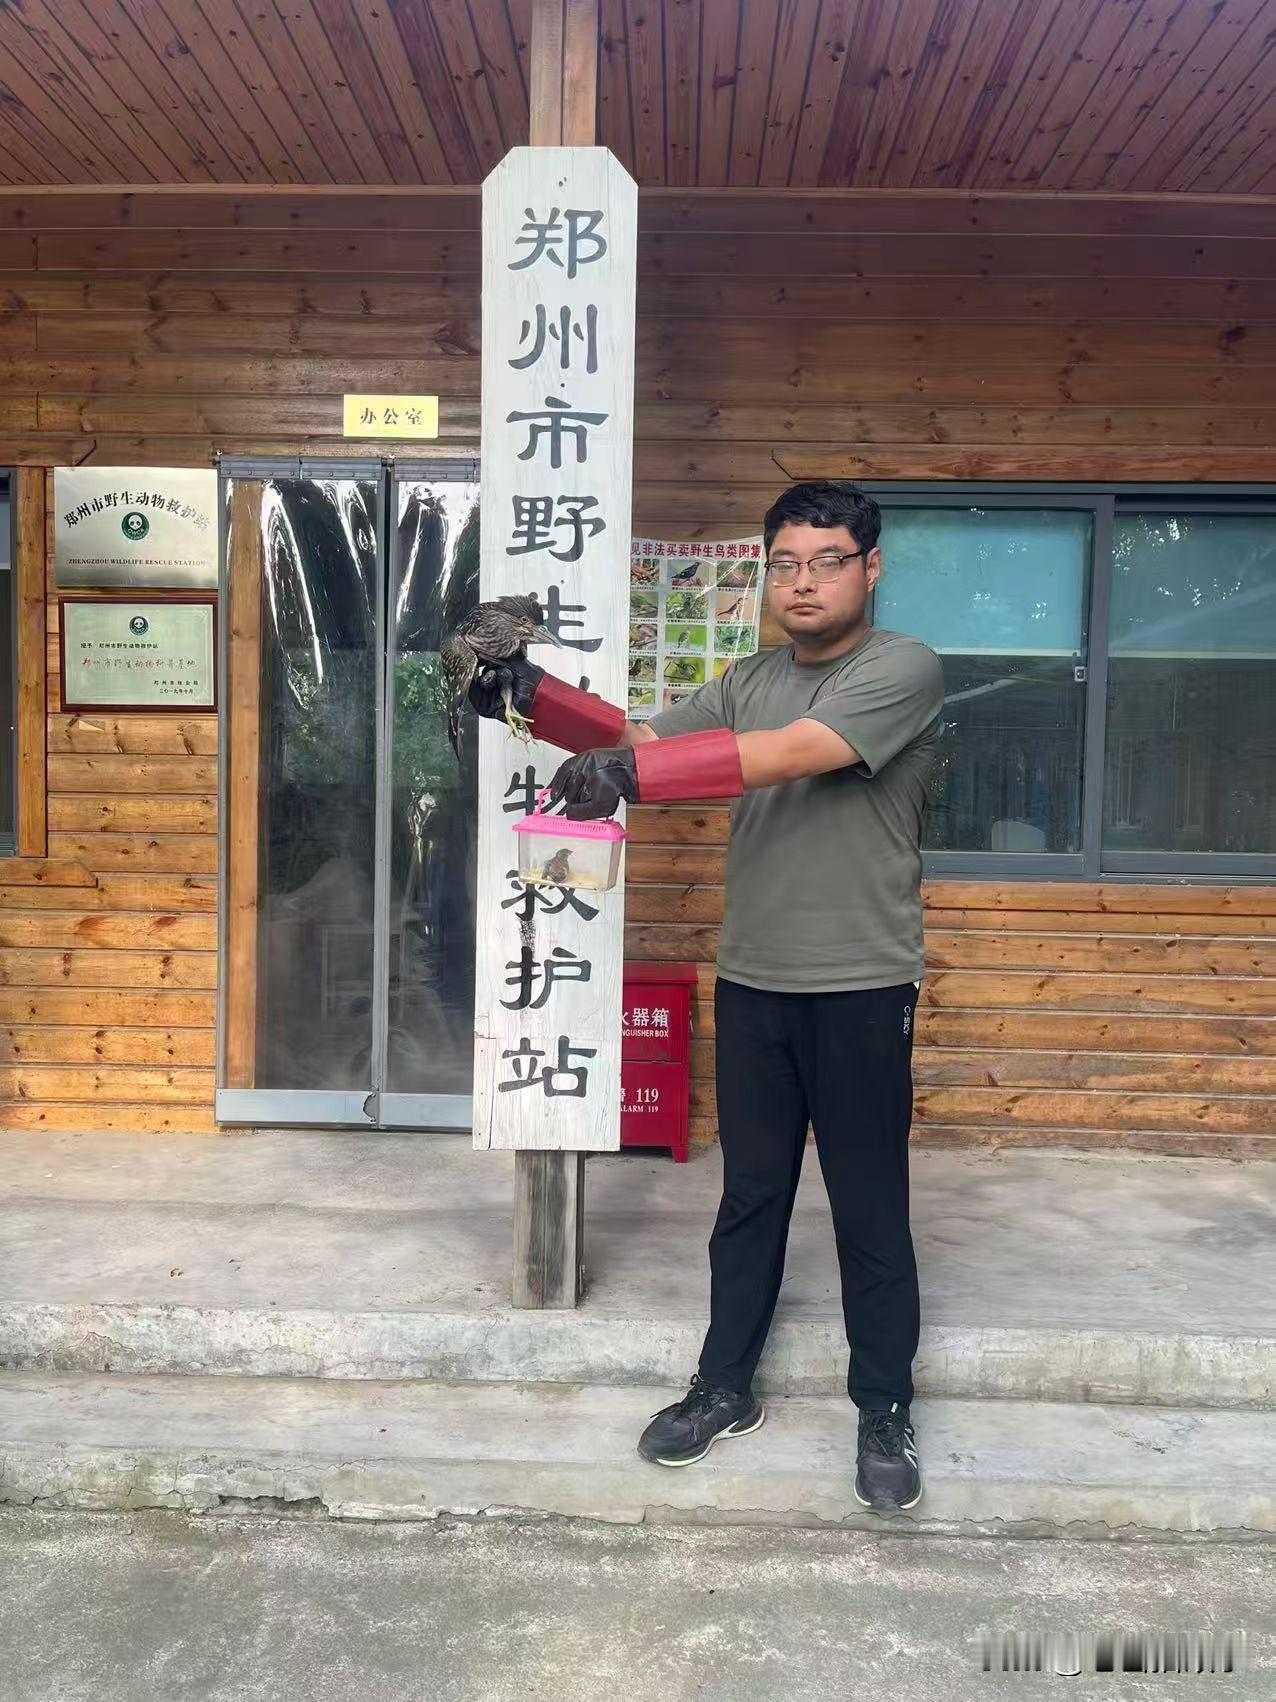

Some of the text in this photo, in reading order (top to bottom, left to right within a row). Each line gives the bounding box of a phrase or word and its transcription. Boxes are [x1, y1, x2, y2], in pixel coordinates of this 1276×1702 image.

[360, 407, 423, 425] 办公室
[64, 491, 210, 531] 郑州市野生动物救护站
[498, 207, 609, 1098] 郑州市野生物救护站
[636, 1088, 659, 1103] 119
